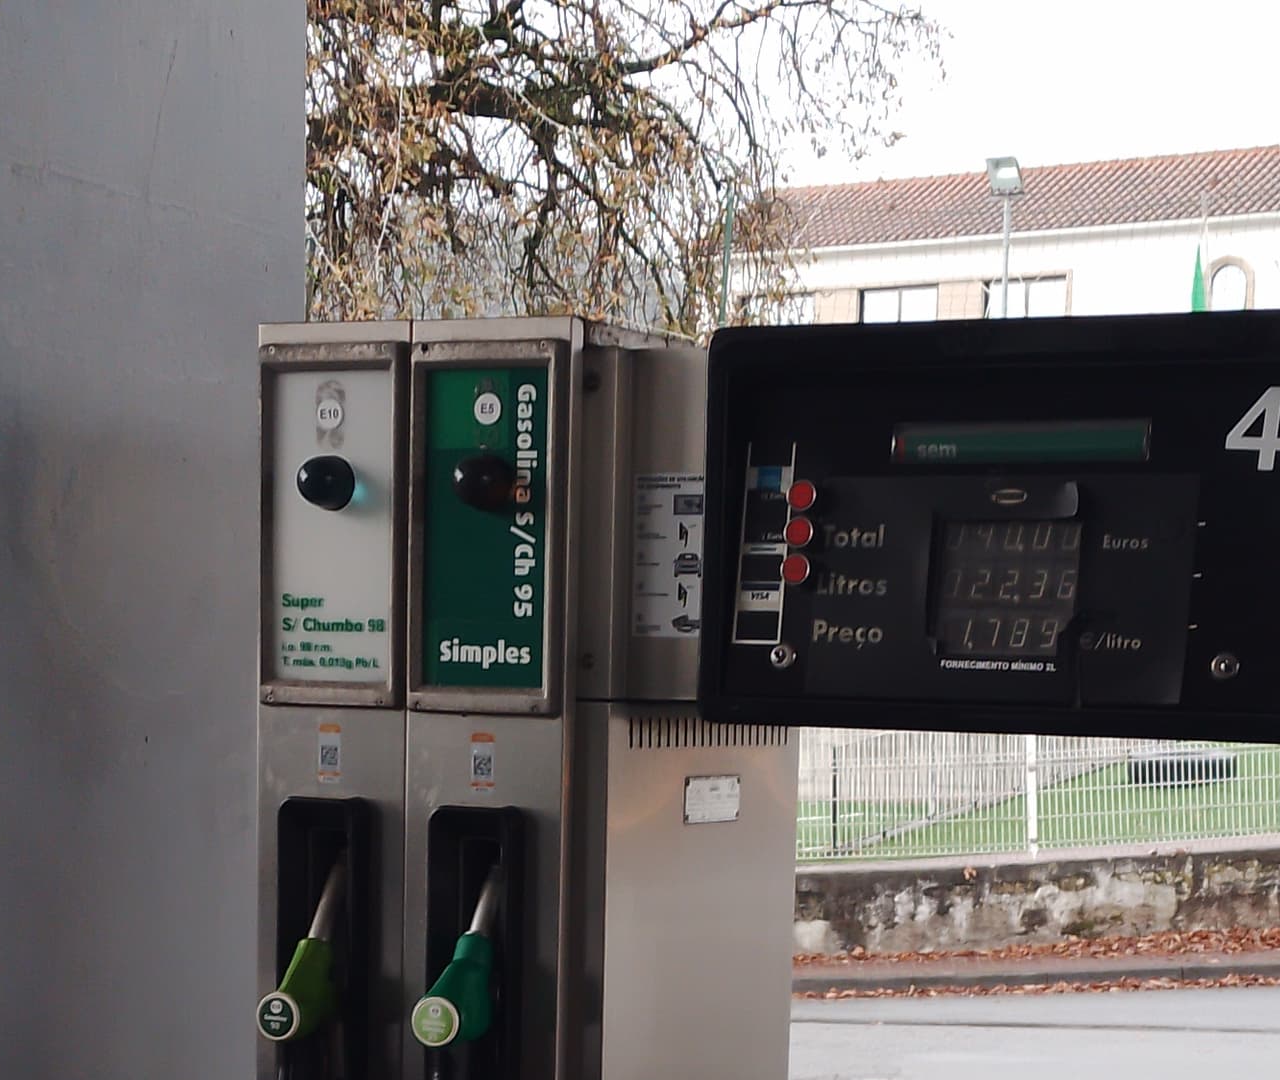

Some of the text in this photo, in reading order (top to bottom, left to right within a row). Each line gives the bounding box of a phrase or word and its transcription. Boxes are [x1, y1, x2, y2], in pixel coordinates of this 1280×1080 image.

[319, 408, 339, 420] E10
[480, 403, 495, 415] E5
[916, 442, 957, 458] sem
[510, 383, 538, 617] Gasolina S/Ch 95
[823, 523, 886, 548] Total
[1102, 533, 1150, 550] Euros
[817, 572, 888, 596] Litros
[282, 593, 324, 610] Super
[751, 589, 770, 600] VISA
[282, 617, 386, 632] S/ Chumbo 98
[812, 618, 883, 650] Preço
[439, 637, 531, 669] Simples
[940, 658, 1009, 671] FORNECIMENTO
[1011, 659, 1043, 671] MÍNIMO
